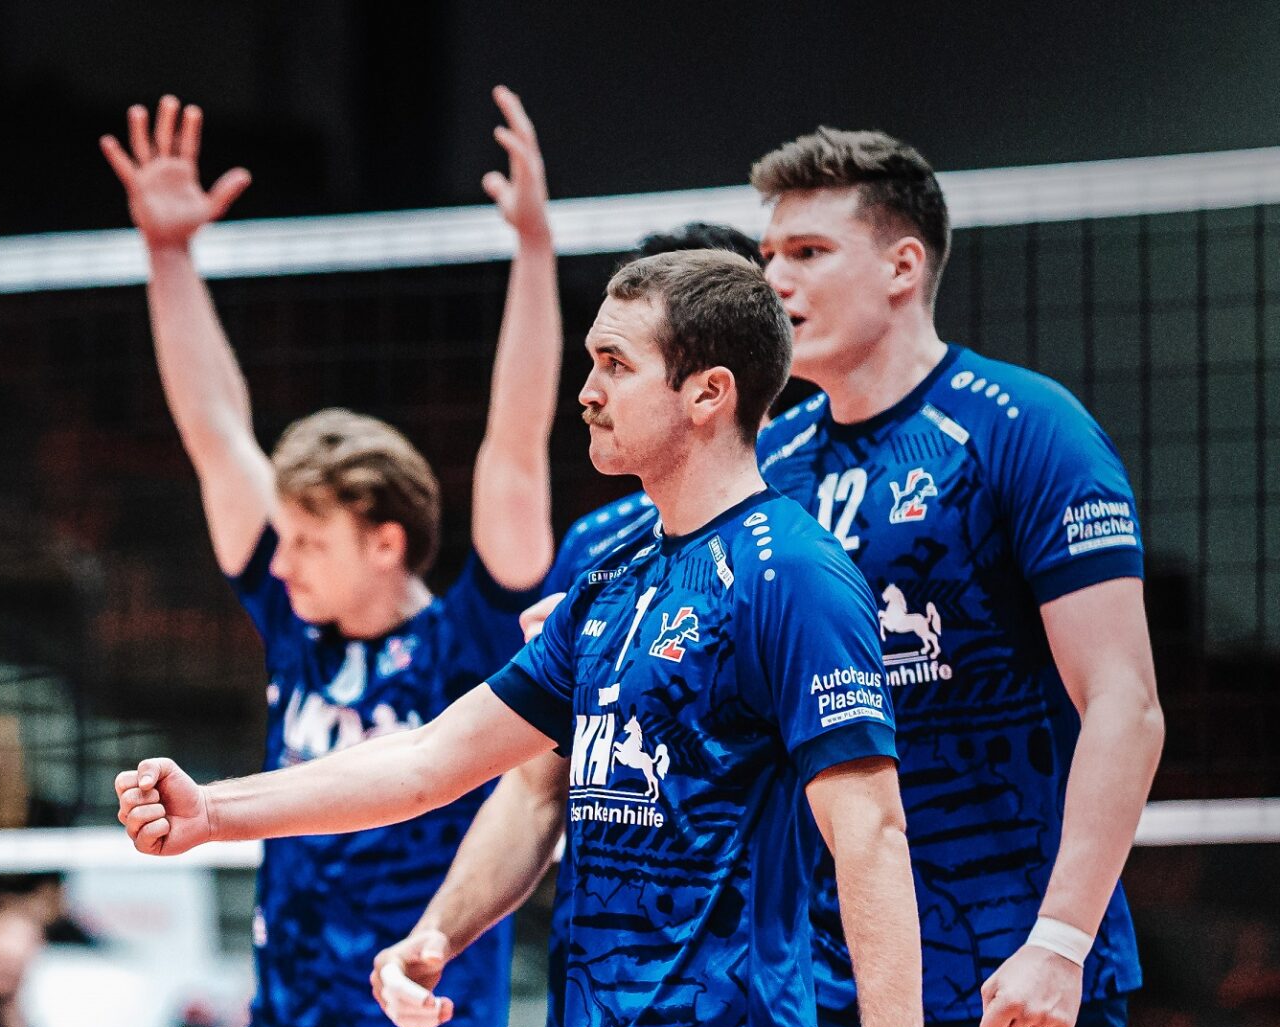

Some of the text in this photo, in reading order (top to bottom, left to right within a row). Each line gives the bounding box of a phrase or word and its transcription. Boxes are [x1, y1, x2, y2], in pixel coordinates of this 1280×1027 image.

[817, 467, 868, 552] 12
[1062, 499, 1130, 527] Autohaus
[1067, 516, 1134, 544] Plaschka
[810, 665, 882, 696] Autohaus
[886, 660, 952, 686] nhilfe
[818, 688, 883, 715] Plaschka
